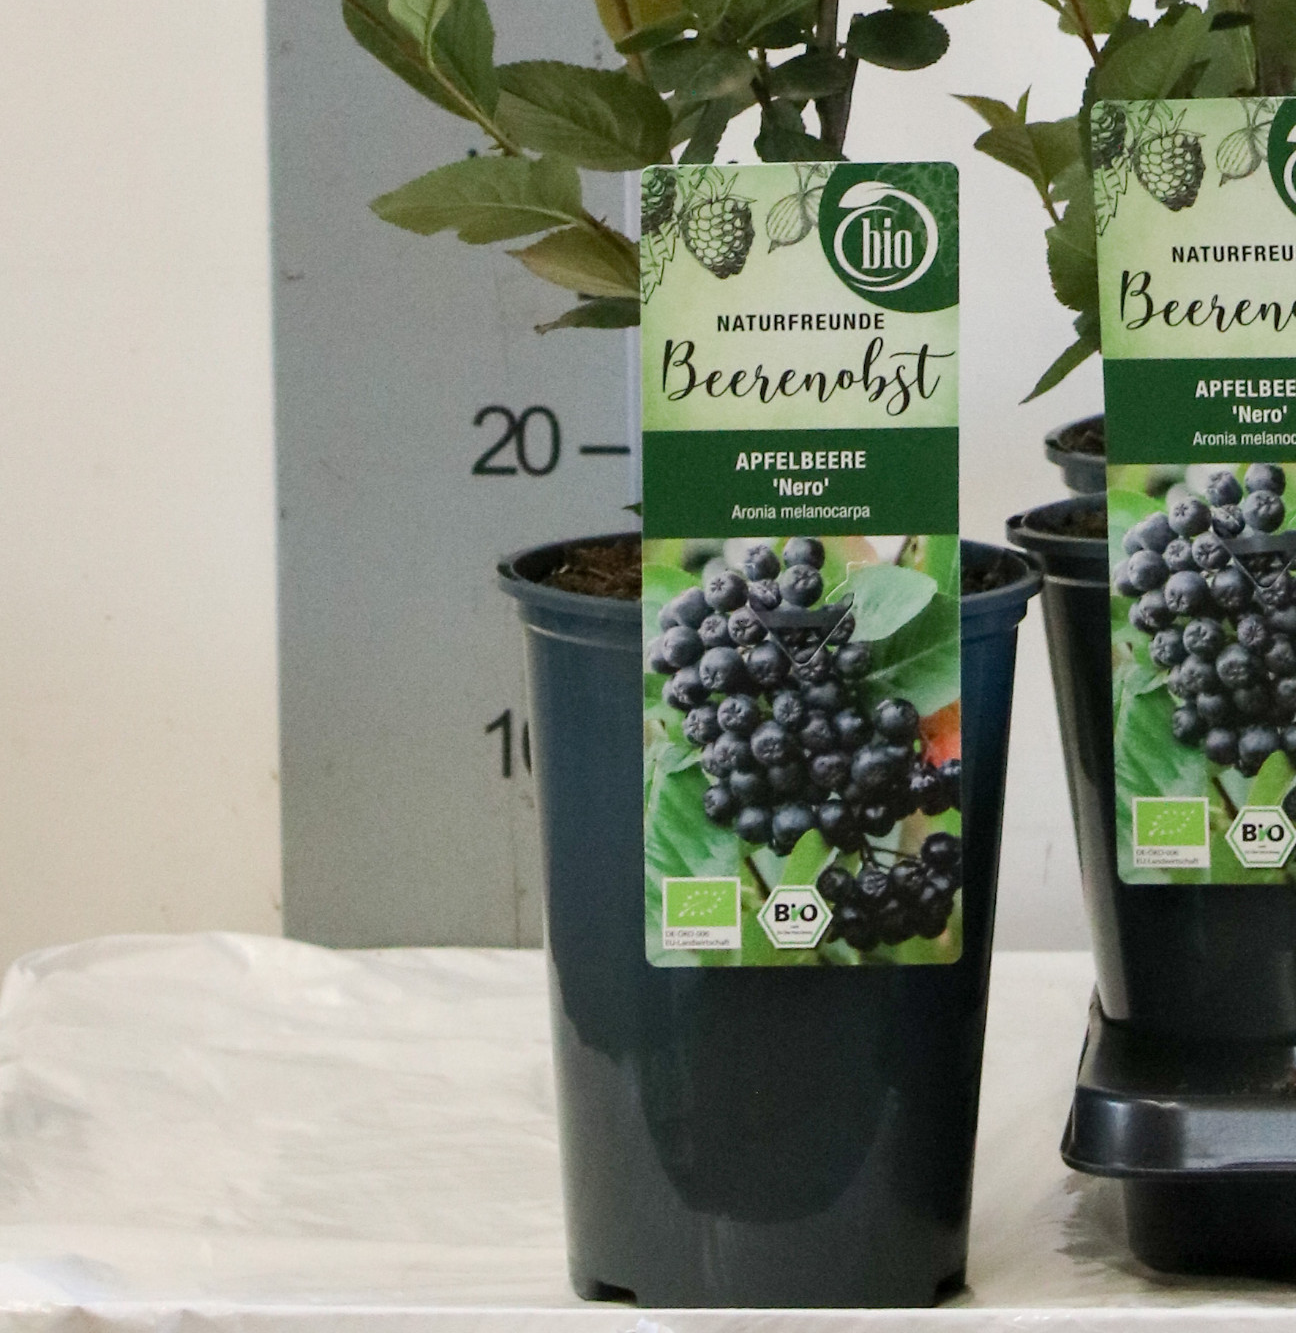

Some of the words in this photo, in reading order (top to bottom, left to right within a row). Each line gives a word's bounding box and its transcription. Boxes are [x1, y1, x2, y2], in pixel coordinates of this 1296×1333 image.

[861, 217, 914, 270] bio
[717, 312, 886, 332] NATURFREUNDE
[662, 336, 956, 417] Beerenobst
[1232, 405, 1288, 424] 'Nero'
[471, 404, 561, 477] 20
[1193, 430, 1237, 446] Aronia
[735, 450, 867, 471] APFELBEERE
[772, 477, 830, 497] 'Nero'
[731, 503, 777, 520] Aronia
[780, 503, 871, 521] melanocarpa
